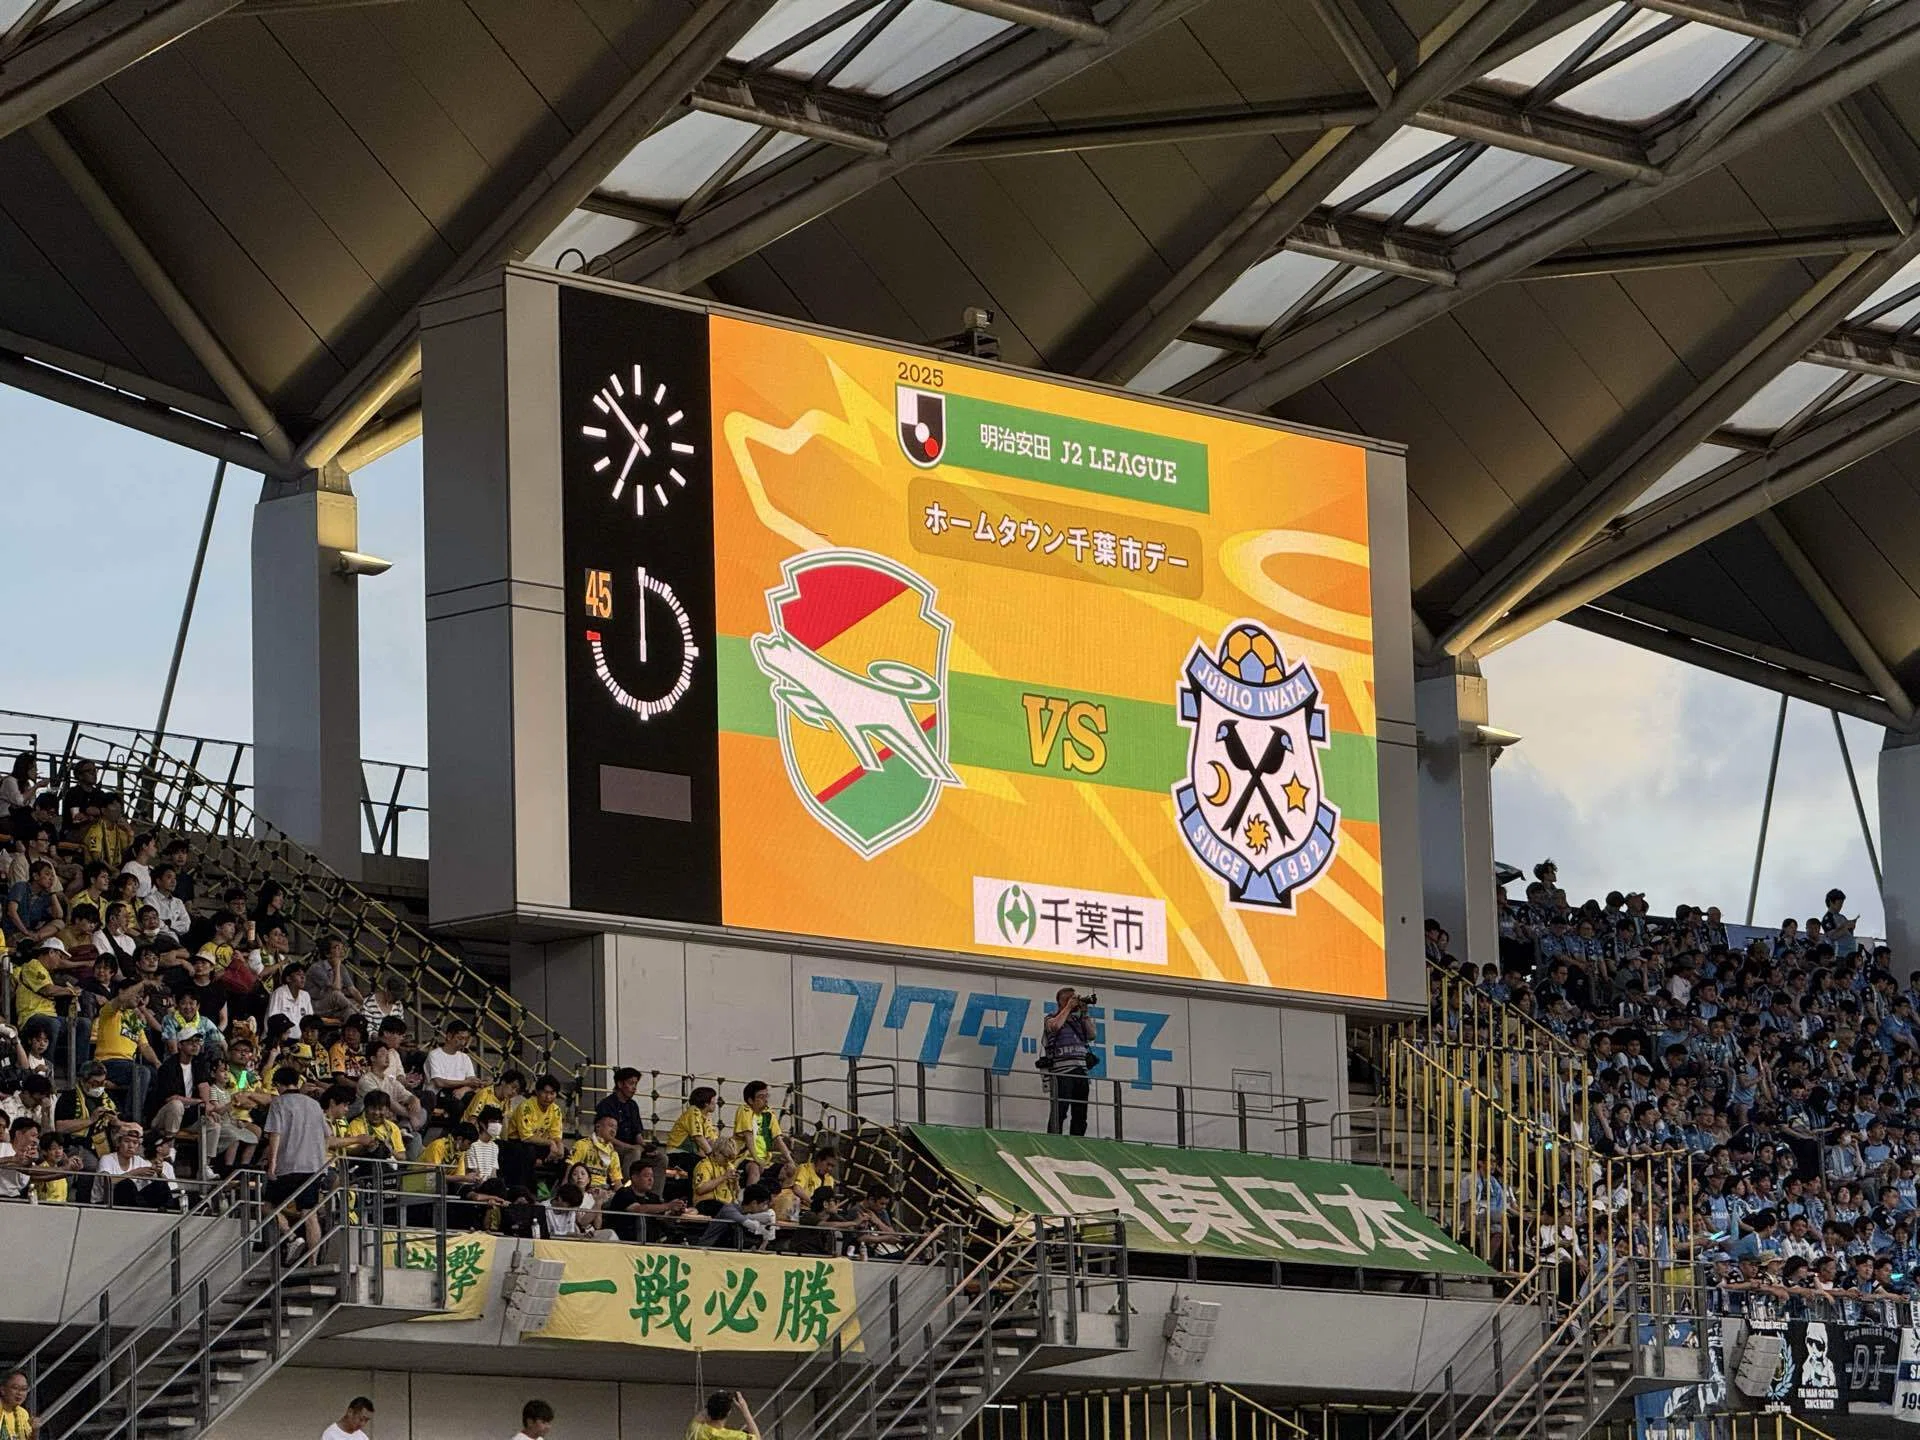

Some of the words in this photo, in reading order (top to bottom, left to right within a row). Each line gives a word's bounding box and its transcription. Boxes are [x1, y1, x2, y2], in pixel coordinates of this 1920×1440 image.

[897, 362, 944, 387] 2025
[979, 423, 1051, 461] 明治安田
[1060, 440, 1083, 466] J2
[1089, 446, 1177, 484] LEAGUE
[924, 502, 1189, 573] ホームタウン千葉市デー
[585, 571, 612, 619] 45
[1259, 677, 1308, 713] IWATA
[1021, 692, 1108, 775] VS
[1193, 825, 1242, 880] SINCE
[1276, 840, 1324, 886] 1992
[1040, 897, 1144, 954] 千葉市
[558, 1253, 842, 1346] 一戦必勝
